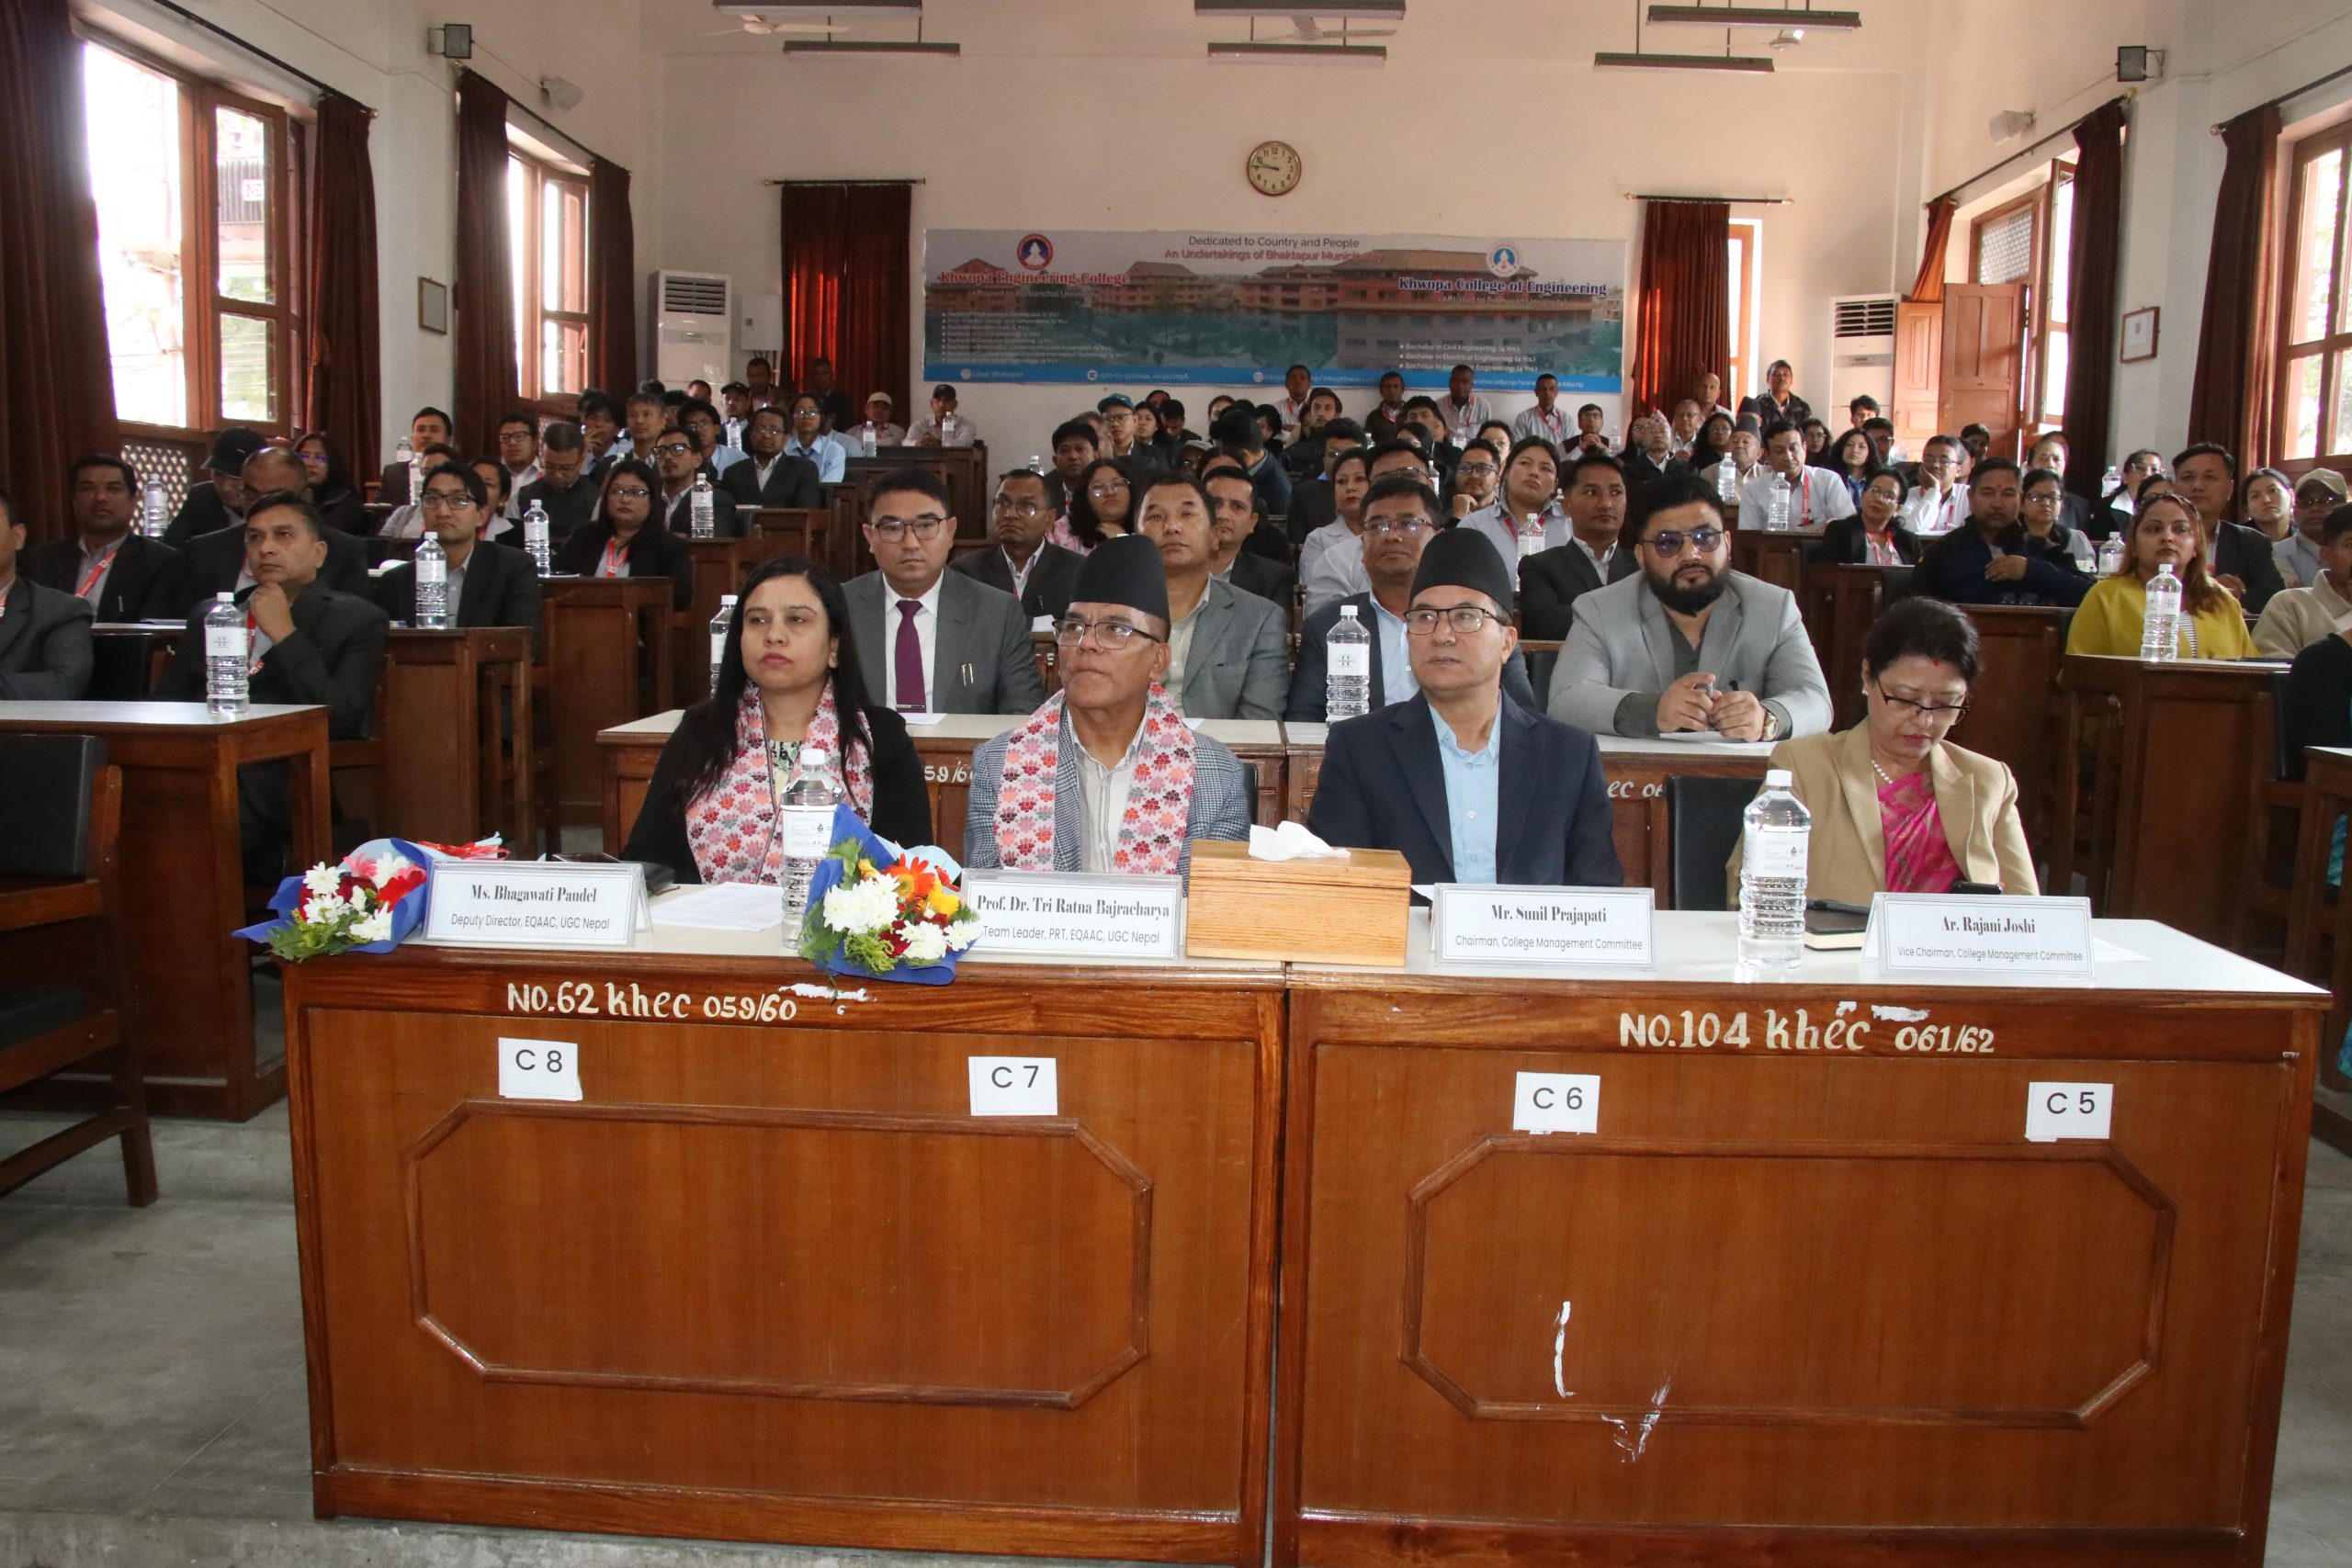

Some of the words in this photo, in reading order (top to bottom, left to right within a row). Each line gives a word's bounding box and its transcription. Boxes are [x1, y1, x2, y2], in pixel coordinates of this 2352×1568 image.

[1189, 236, 1242, 246] Dedicated
[1245, 237, 1255, 246] to
[1257, 237, 1298, 248] Country
[1300, 238, 1320, 247] and
[1323, 238, 1360, 249] People
[1165, 249, 1179, 259] An
[1182, 249, 1251, 261] Undertakings
[1253, 250, 1265, 260] of
[1266, 250, 1319, 262] Bhaktapur
[940, 271, 993, 285] Khwopa
[997, 271, 1076, 286] Engineering
[1081, 272, 1130, 286] College
[1398, 277, 1452, 292] Khwopa
[1456, 278, 1505, 292] College
[1510, 280, 1523, 292] of
[1527, 281, 1607, 296] Engineering
[471, 885, 490, 900] Ms.
[495, 885, 553, 904] Bhagawati
[557, 887, 597, 902] Paudel
[977, 895, 1006, 910] Prof.
[1010, 896, 1029, 911] Dr.
[1033, 897, 1052, 913] Tri
[1056, 898, 1092, 914] Ratna
[1096, 899, 1169, 920] Bajracharya
[1492, 905, 1513, 920] Mr.
[1516, 906, 1547, 921] Sunil
[1552, 906, 1607, 926] Prajapati
[451, 914, 483, 928] Deputy
[486, 914, 522, 928] Director,
[525, 916, 558, 929] EQAAC,
[561, 917, 580, 928] UGC
[583, 918, 610, 932] Nepal
[1942, 916, 1959, 931] Ar.
[1962, 917, 2001, 936] Rajani
[2004, 918, 2035, 933] Joshi
[984, 926, 1010, 938] Team
[1012, 927, 1046, 940] Leader,
[1049, 928, 1068, 941] PRT,
[1071, 929, 1105, 943] EQAAC,
[1108, 931, 1129, 943] UGC
[1132, 931, 1159, 946] Nepal
[1455, 935, 1500, 947] Chairman,
[1502, 936, 1534, 950] College
[1536, 938, 1593, 951] Management
[1596, 939, 1643, 949] Committee
[1897, 946, 1914, 956] Vice
[1916, 947, 1956, 959] Chairman,
[1957, 949, 1986, 961] College
[1988, 950, 2038, 962] Management
[2040, 951, 2082, 961] Committee
[703, 993, 797, 1022] 059/60
[1894, 1024, 1995, 1053] 061/62
[515, 1049, 536, 1071] C
[547, 1050, 563, 1073] 8
[991, 1065, 1013, 1089] C
[1022, 1065, 1040, 1089] 7
[1532, 1087, 1554, 1110] C
[1565, 1086, 1584, 1110] 6
[2046, 1091, 2068, 1115] C
[2078, 1092, 2096, 1115] 5
